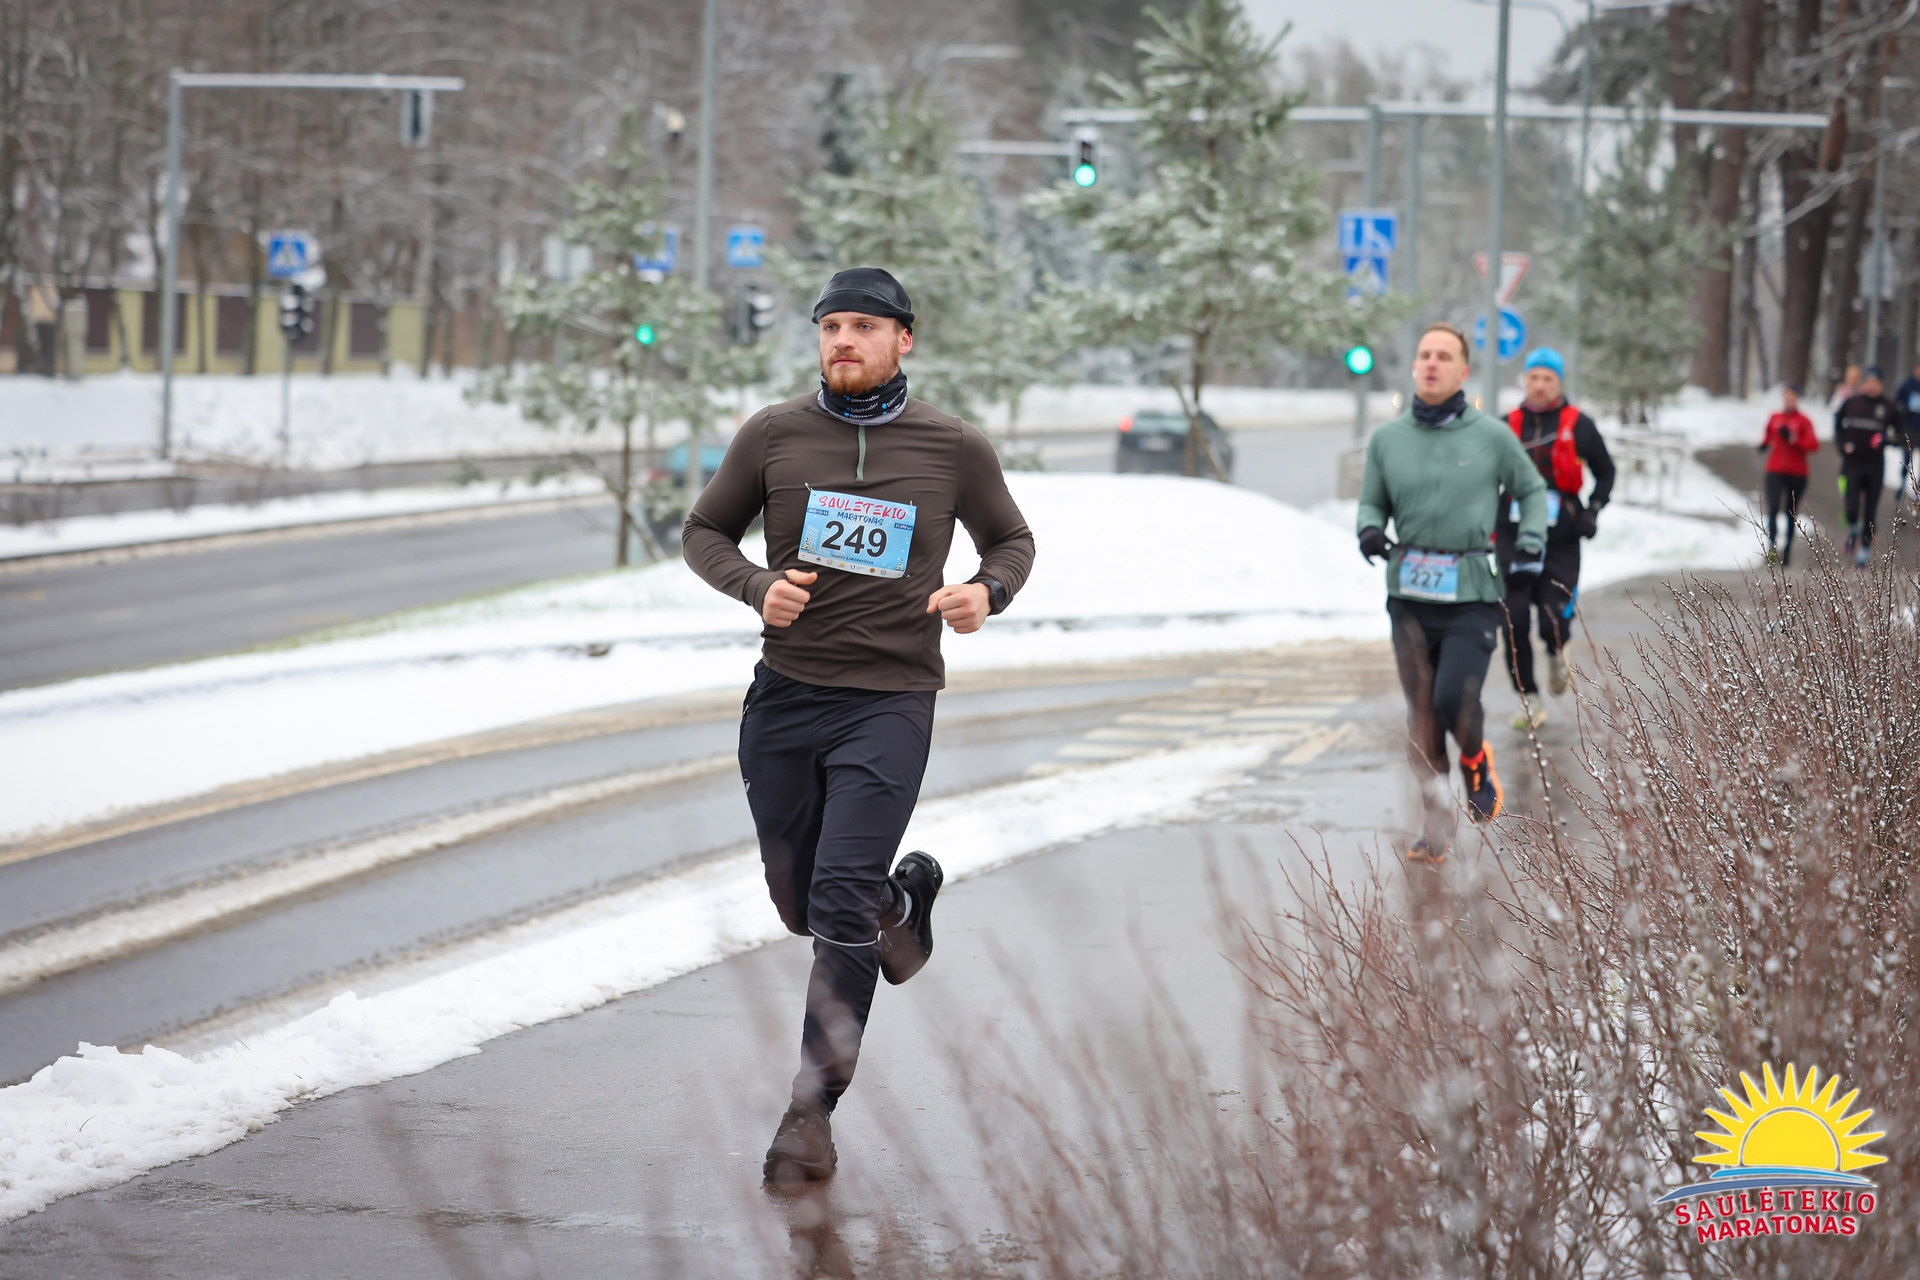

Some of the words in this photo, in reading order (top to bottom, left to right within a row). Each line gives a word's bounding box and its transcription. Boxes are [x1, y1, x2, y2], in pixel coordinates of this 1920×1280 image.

[837, 511, 884, 526] MARATONAS
[821, 520, 887, 558] 249
[1411, 570, 1443, 589] 227
